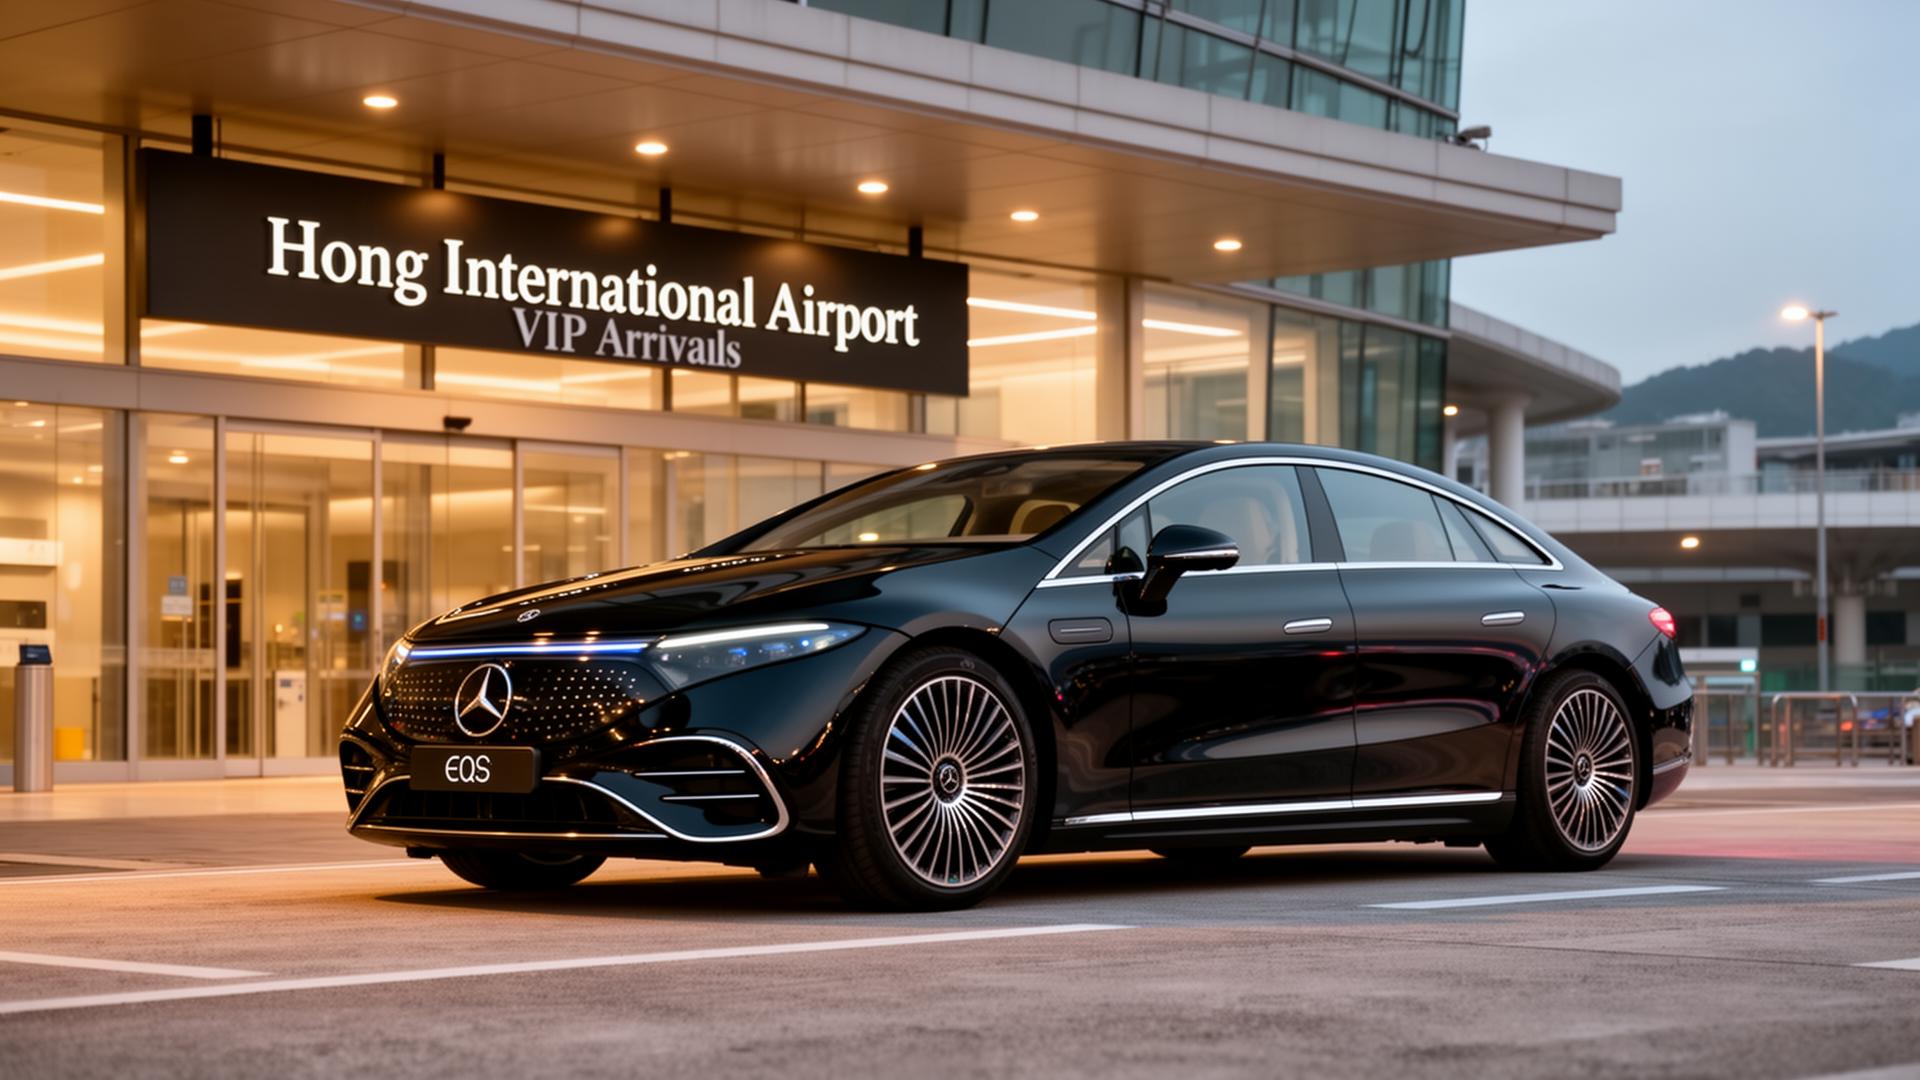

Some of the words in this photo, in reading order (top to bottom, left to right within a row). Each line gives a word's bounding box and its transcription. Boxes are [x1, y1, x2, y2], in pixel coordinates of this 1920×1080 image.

[267, 216, 429, 307] Hong
[443, 238, 757, 329] International
[765, 282, 921, 353] Airport
[512, 307, 588, 353] VIP
[445, 754, 491, 783] EQS
